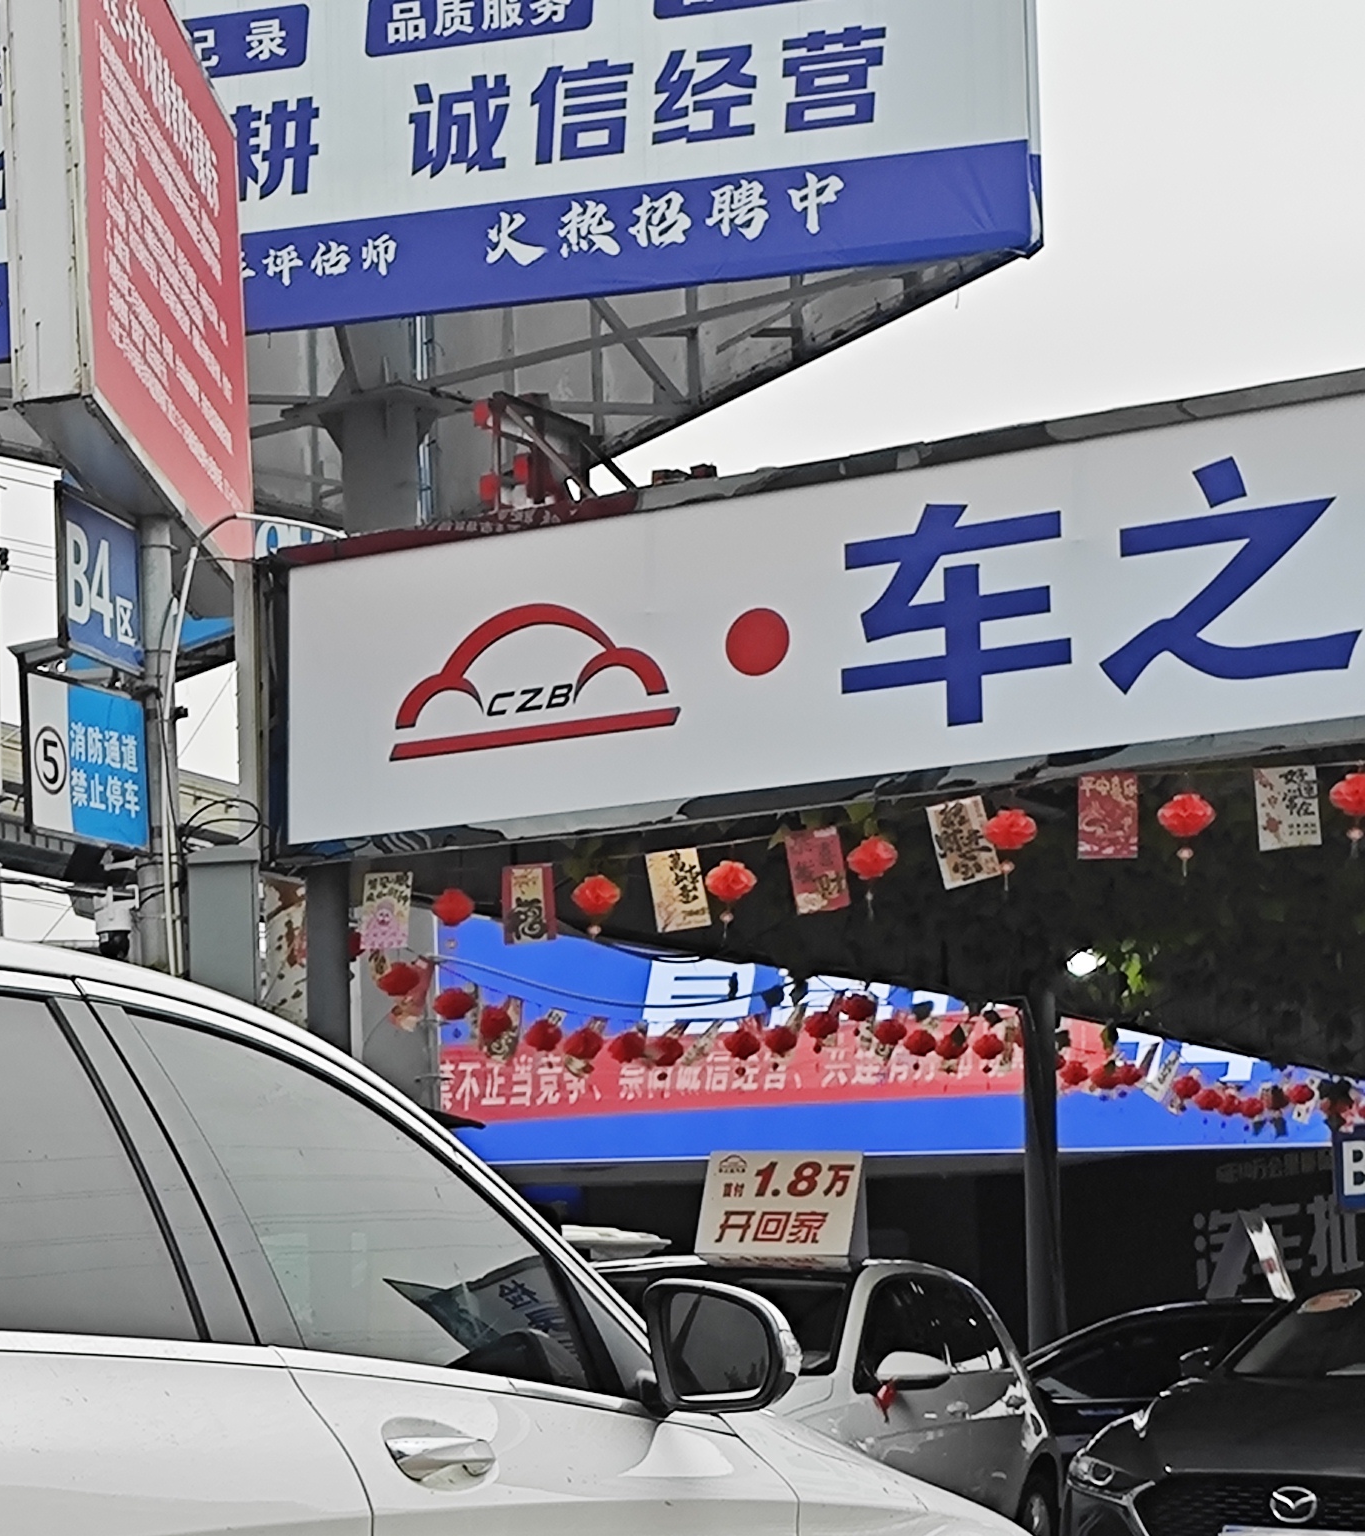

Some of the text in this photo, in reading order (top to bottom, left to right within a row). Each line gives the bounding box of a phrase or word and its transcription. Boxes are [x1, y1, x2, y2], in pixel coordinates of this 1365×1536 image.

[407, 25, 887, 179] 诚信经营
[484, 171, 846, 268] 火热招聘中
[65, 519, 136, 647] B4区
[841, 456, 1363, 727] 车之
[486, 682, 575, 717] CZB
[70, 721, 139, 774] 消防通道
[70, 767, 141, 819] 禁止停车
[754, 1161, 856, 1198] 1.8万
[714, 1210, 829, 1244] 开回家
